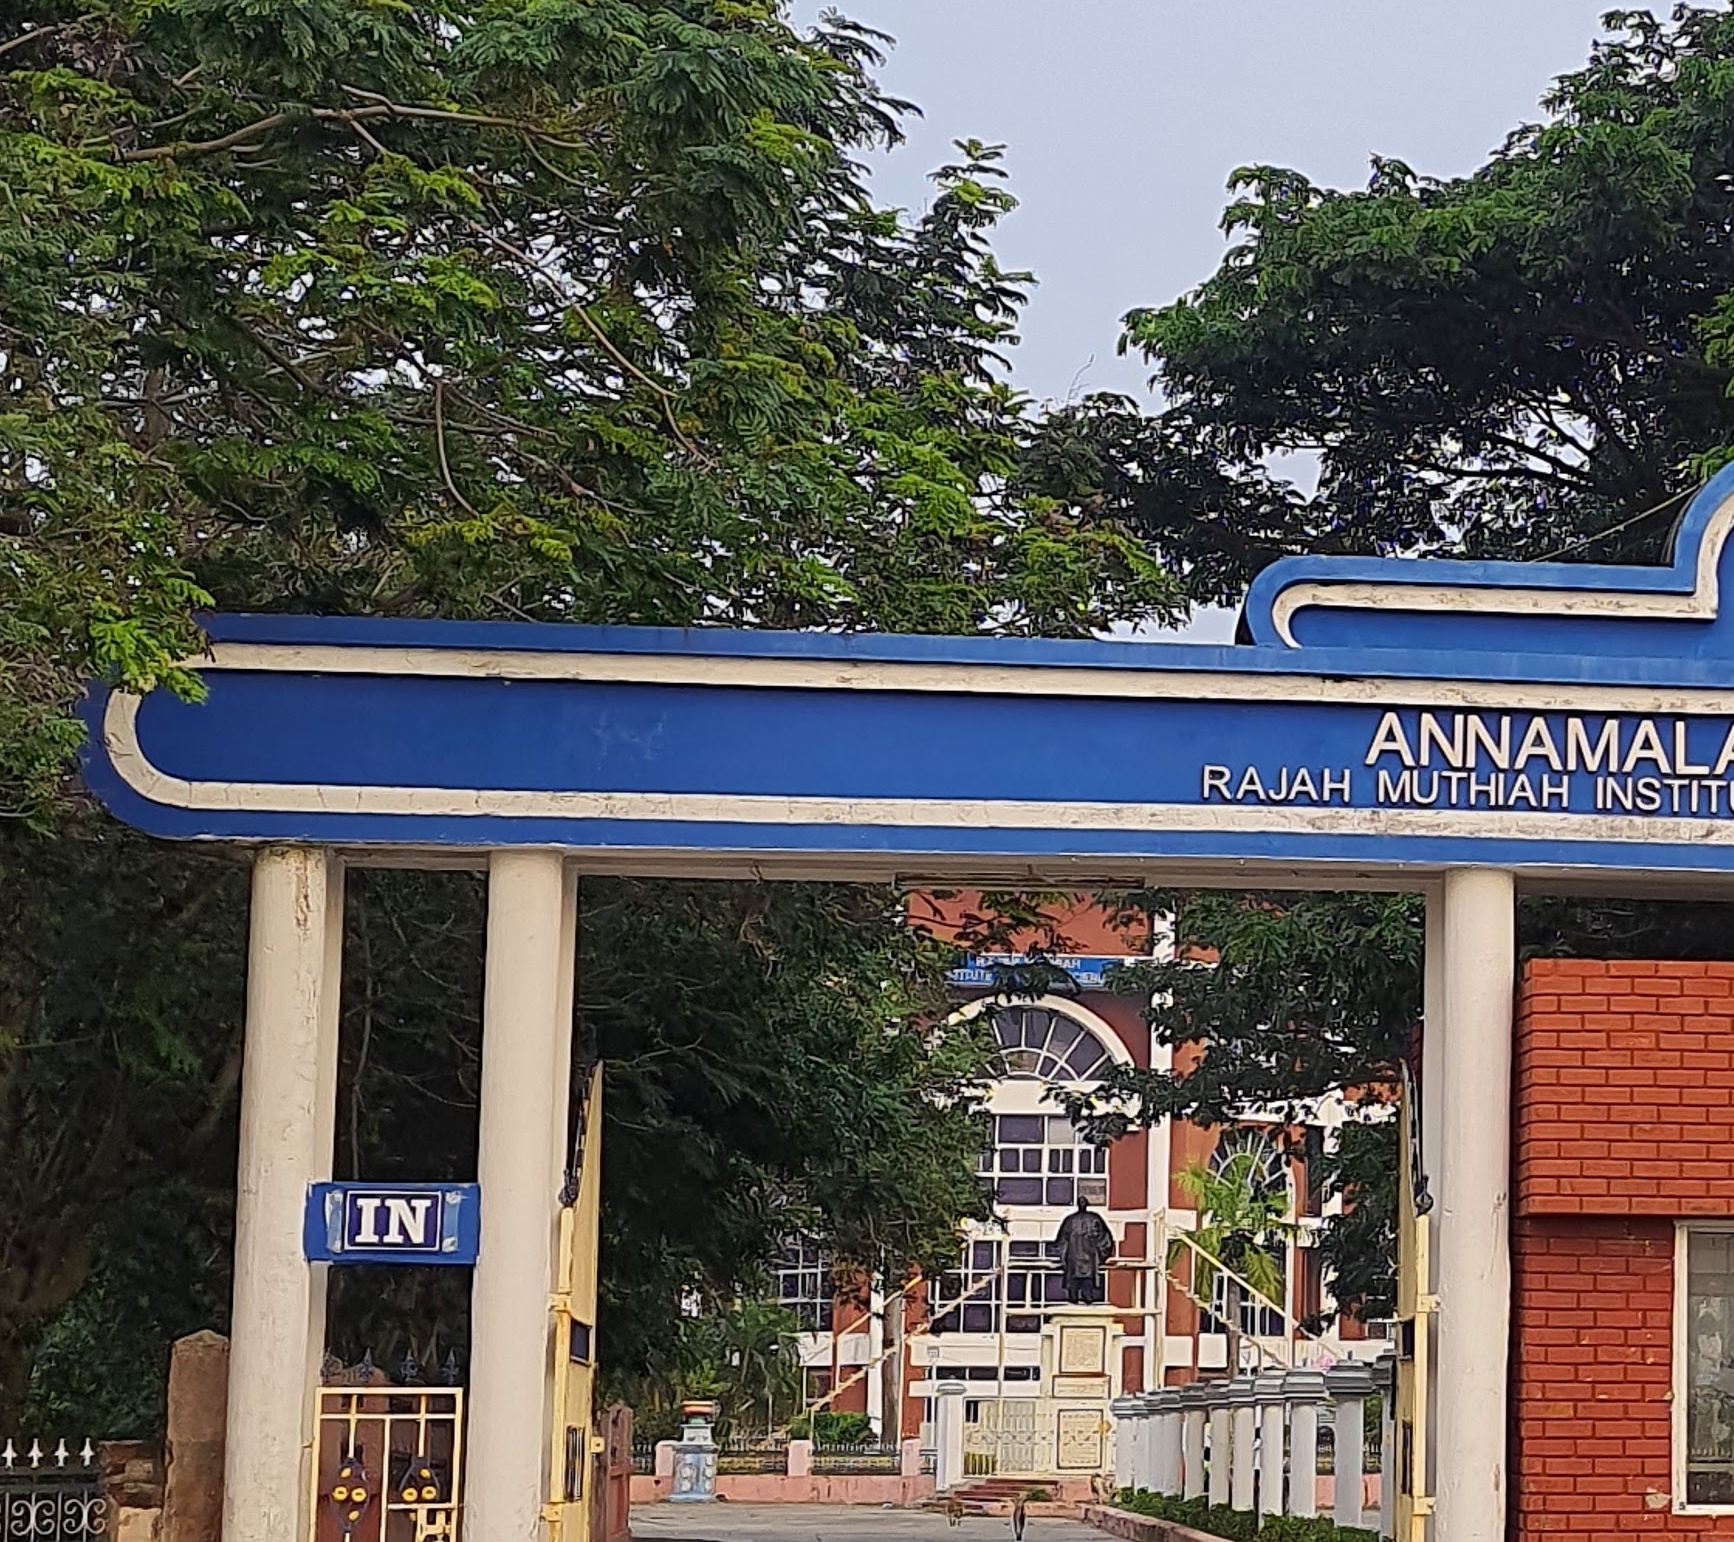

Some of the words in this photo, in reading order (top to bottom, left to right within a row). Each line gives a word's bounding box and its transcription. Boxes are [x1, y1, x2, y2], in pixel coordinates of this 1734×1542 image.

[1202, 764, 1351, 804] RAJAH
[1377, 768, 1570, 809] MUTHIAH
[354, 1197, 432, 1244] IN
